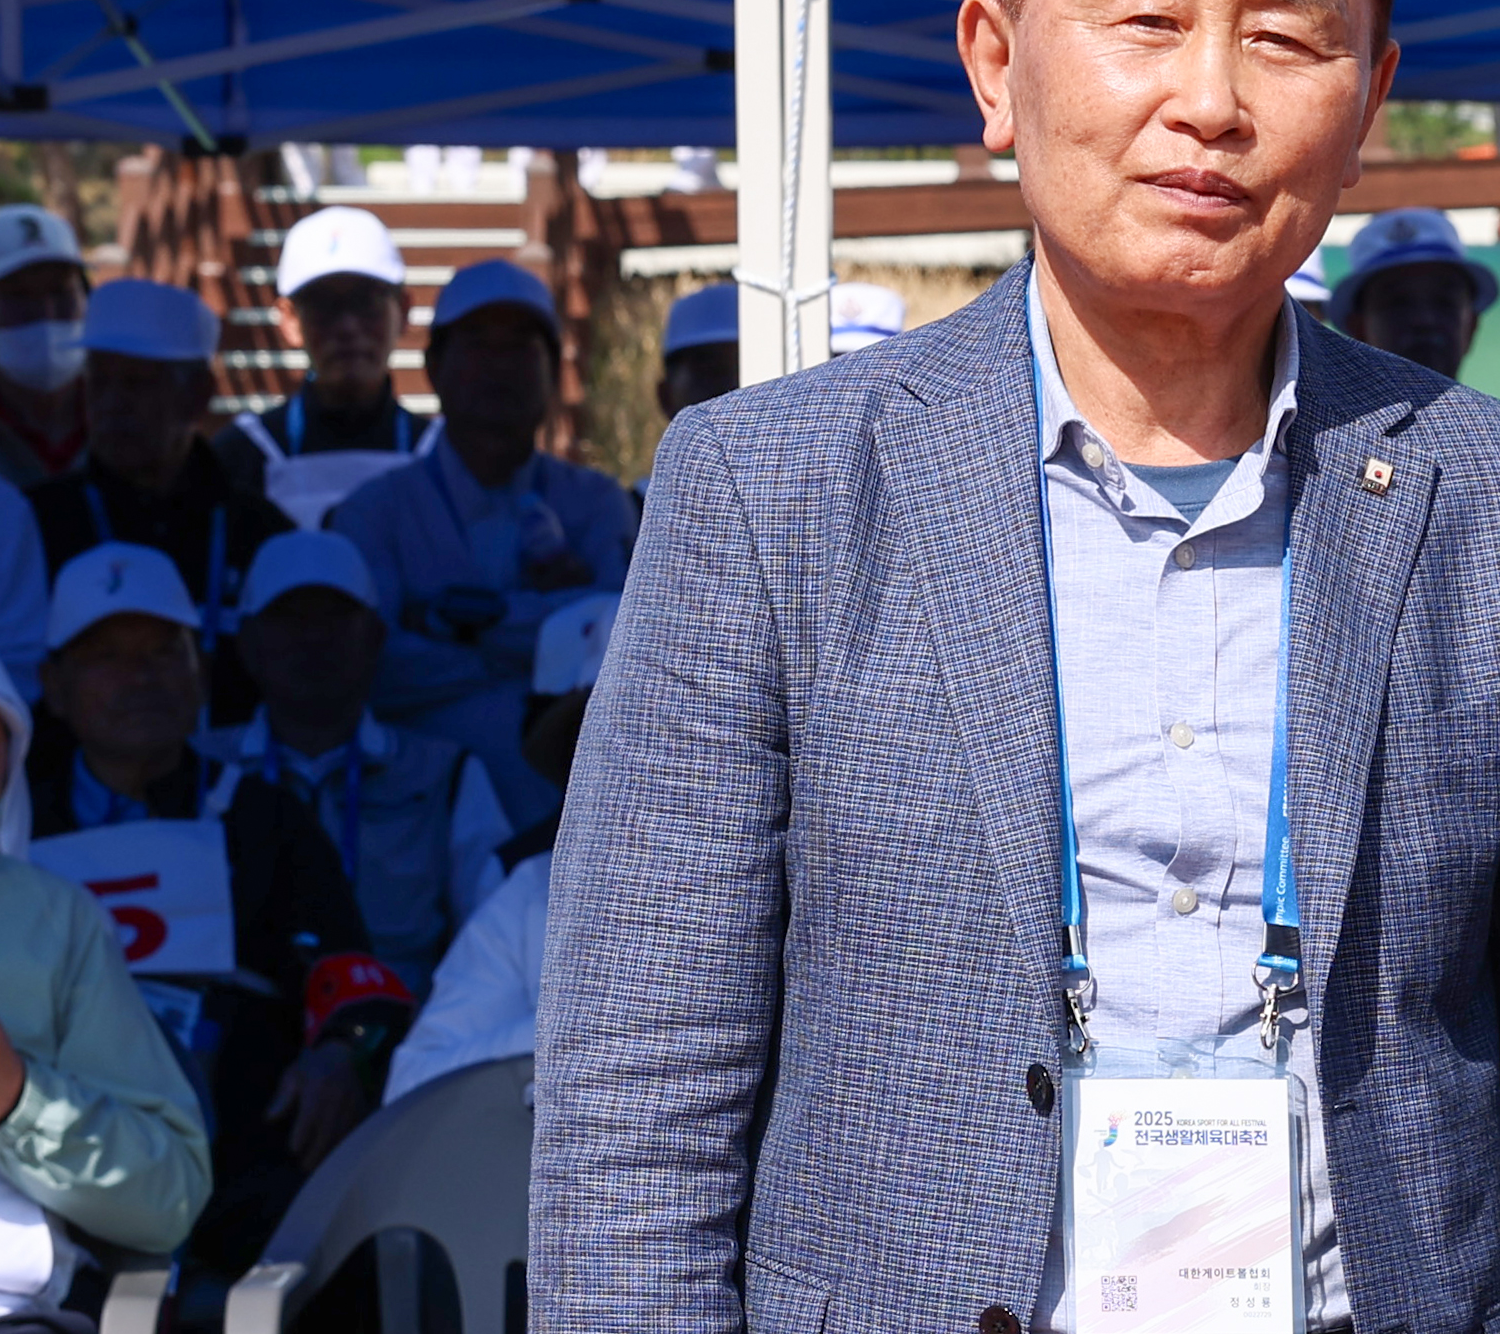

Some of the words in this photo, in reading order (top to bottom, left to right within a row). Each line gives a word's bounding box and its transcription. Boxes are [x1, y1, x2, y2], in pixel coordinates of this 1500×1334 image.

[1276, 836, 1290, 894] Committee
[1274, 894, 1285, 926] mpic
[1134, 1111, 1173, 1126] 2025
[1176, 1119, 1196, 1127] KOREA
[1197, 1119, 1216, 1127] SPORT
[1217, 1119, 1228, 1127] FOR
[1229, 1119, 1240, 1127] ALL
[1241, 1119, 1267, 1127] FESTIVAL
[1134, 1129, 1268, 1146] 전국생활체육대축전
[1178, 1267, 1271, 1279] 대한게이트볼협회
